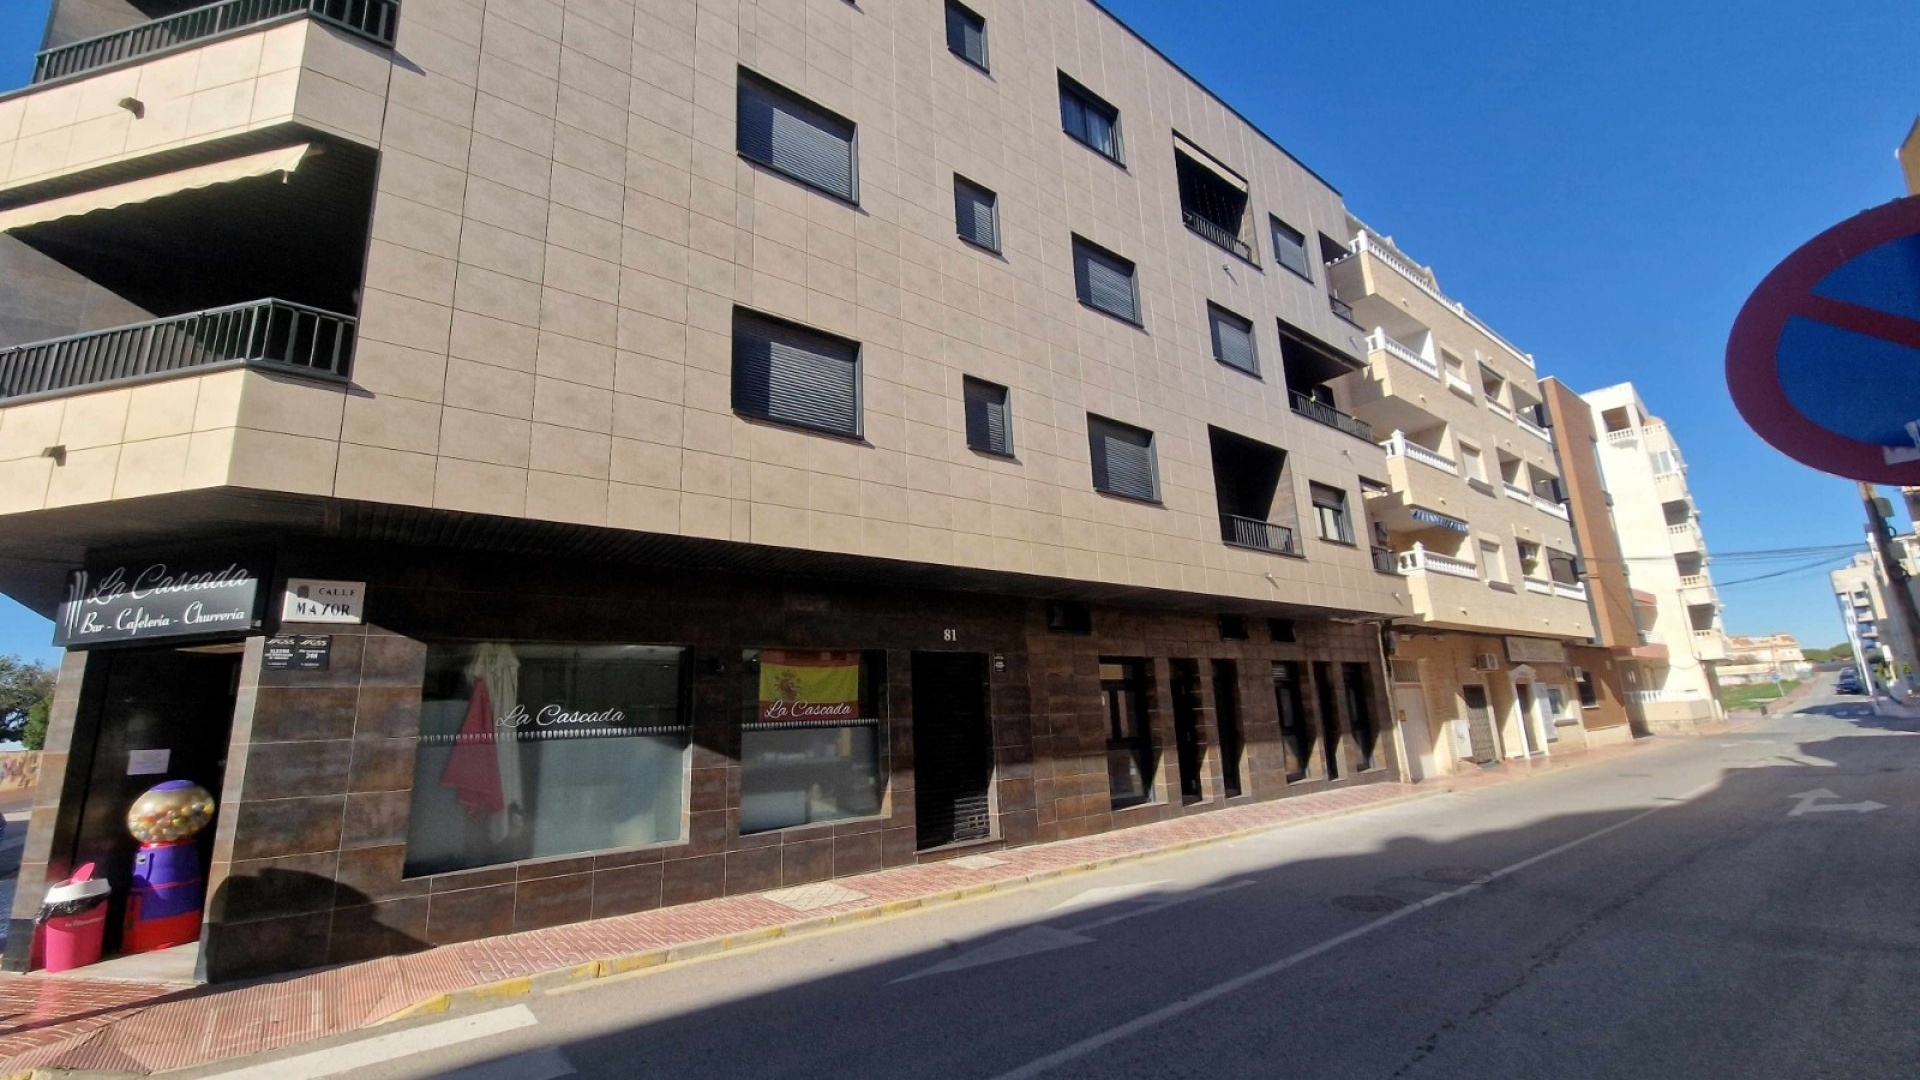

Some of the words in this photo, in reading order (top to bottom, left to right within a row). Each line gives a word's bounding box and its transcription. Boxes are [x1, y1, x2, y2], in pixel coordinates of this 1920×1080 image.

[87, 566, 127, 605] La
[132, 563, 252, 599] Cascada
[318, 587, 356, 597] CALLE
[80, 611, 104, 634] Bar
[116, 607, 170, 636] Cafetería
[184, 600, 245, 625] Churrería
[296, 602, 350, 616] MAYOR
[943, 628, 957, 642] 81
[496, 704, 532, 728] La
[536, 704, 626, 726] Cascada
[764, 700, 788, 719] La
[791, 700, 853, 717] Cascada
